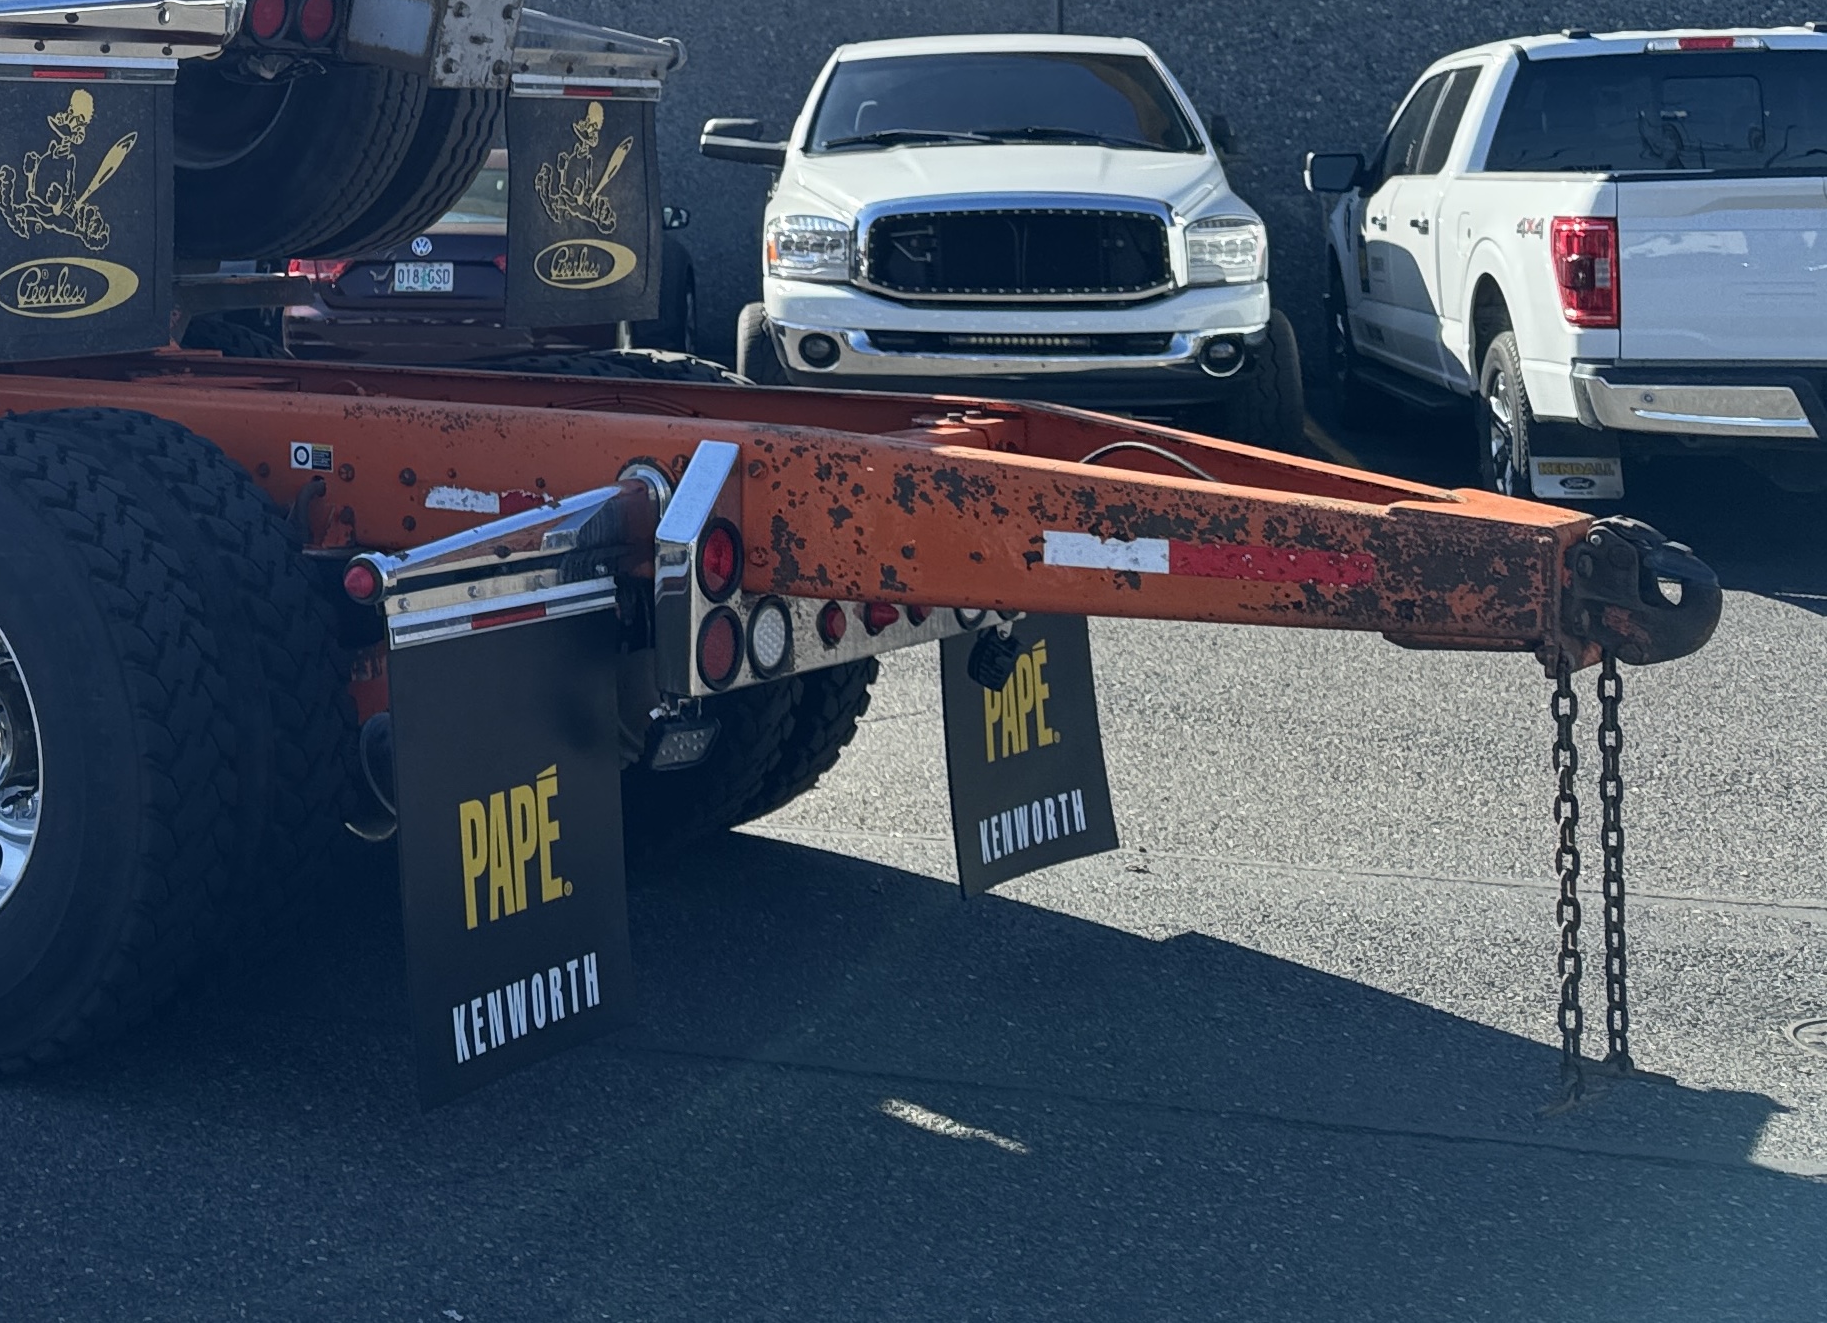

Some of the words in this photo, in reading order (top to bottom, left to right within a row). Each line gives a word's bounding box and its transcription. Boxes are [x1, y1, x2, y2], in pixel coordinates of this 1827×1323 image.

[397, 268, 420, 285] 018
[428, 268, 451, 285] GSD
[550, 247, 601, 280] Peerless
[18, 266, 87, 307] Peerless
[1538, 462, 1616, 477] KENDALL
[459, 763, 563, 930] PAPÉ
[978, 789, 1087, 865] KENWORTH
[451, 952, 601, 1065] KENWORTH
